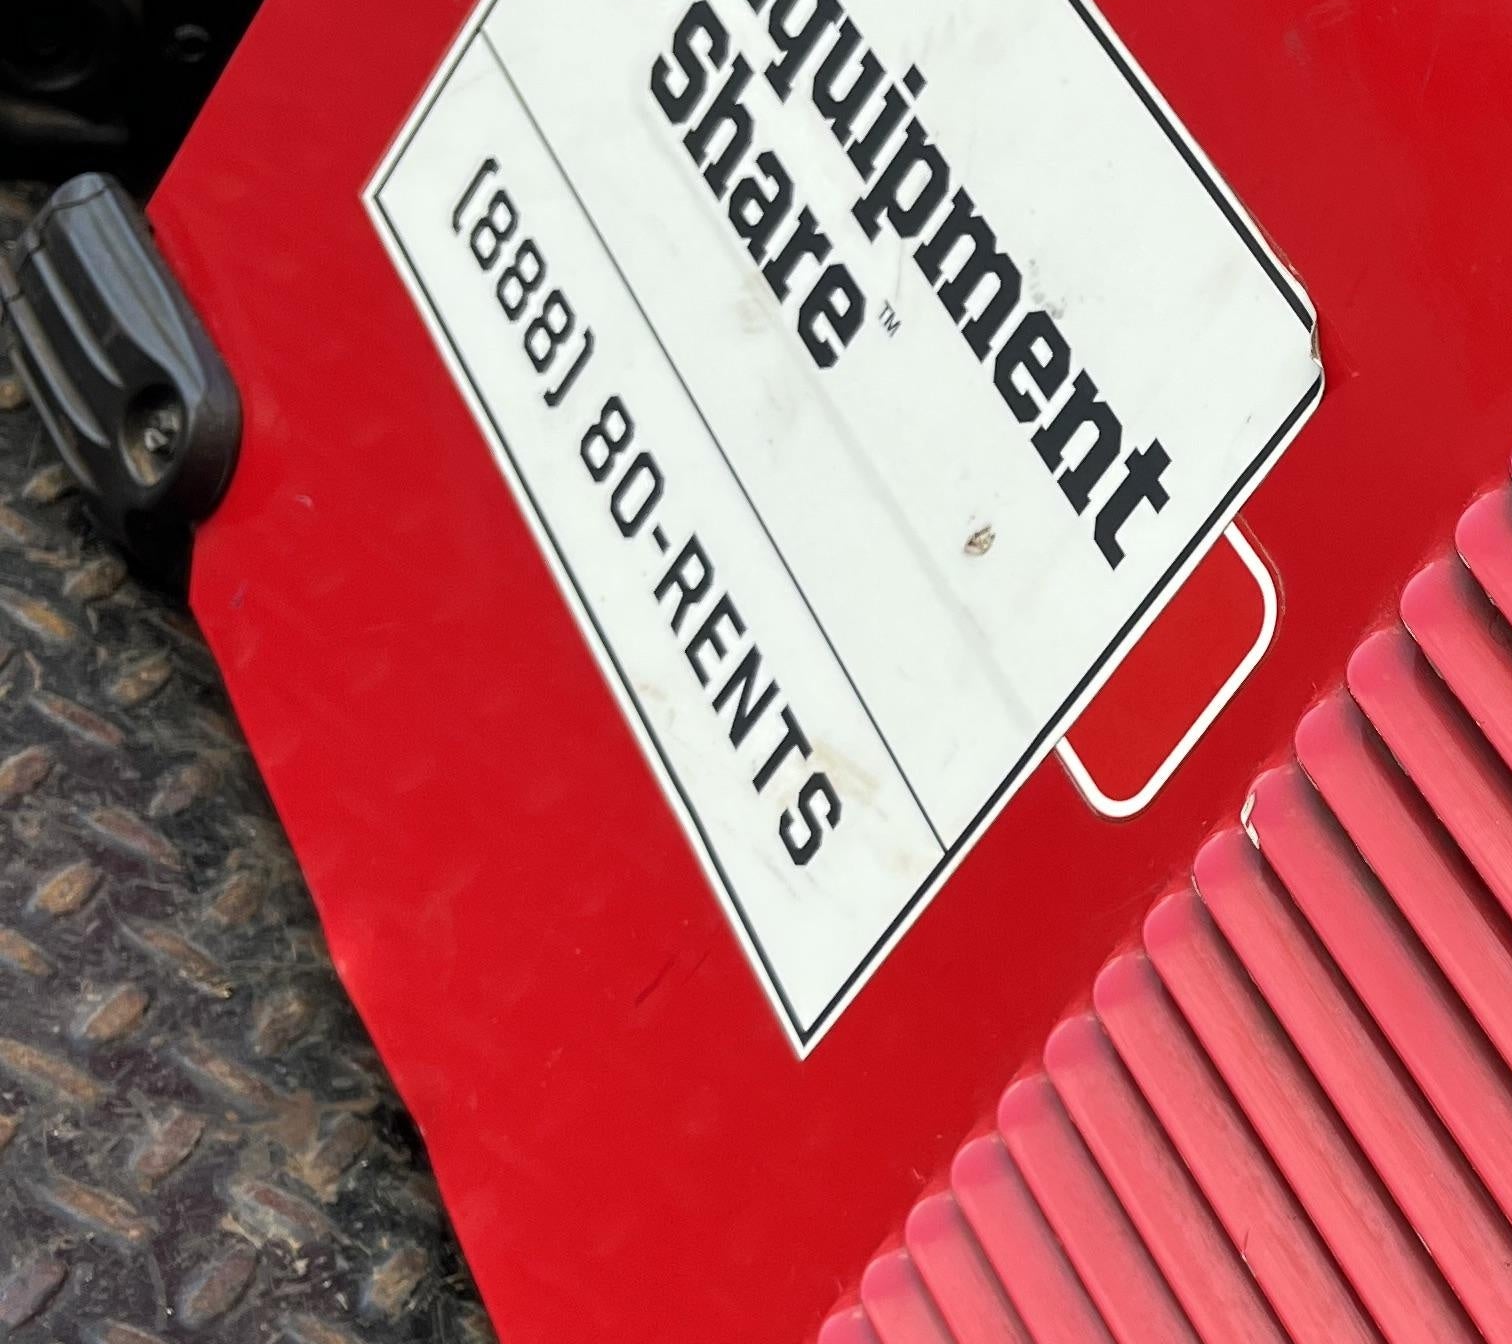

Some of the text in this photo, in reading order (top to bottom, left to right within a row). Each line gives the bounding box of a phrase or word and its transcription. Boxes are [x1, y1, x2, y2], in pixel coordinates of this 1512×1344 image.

[650, 0, 867, 370] Share
[451, 157, 842, 867] (888) 80-RENTS
